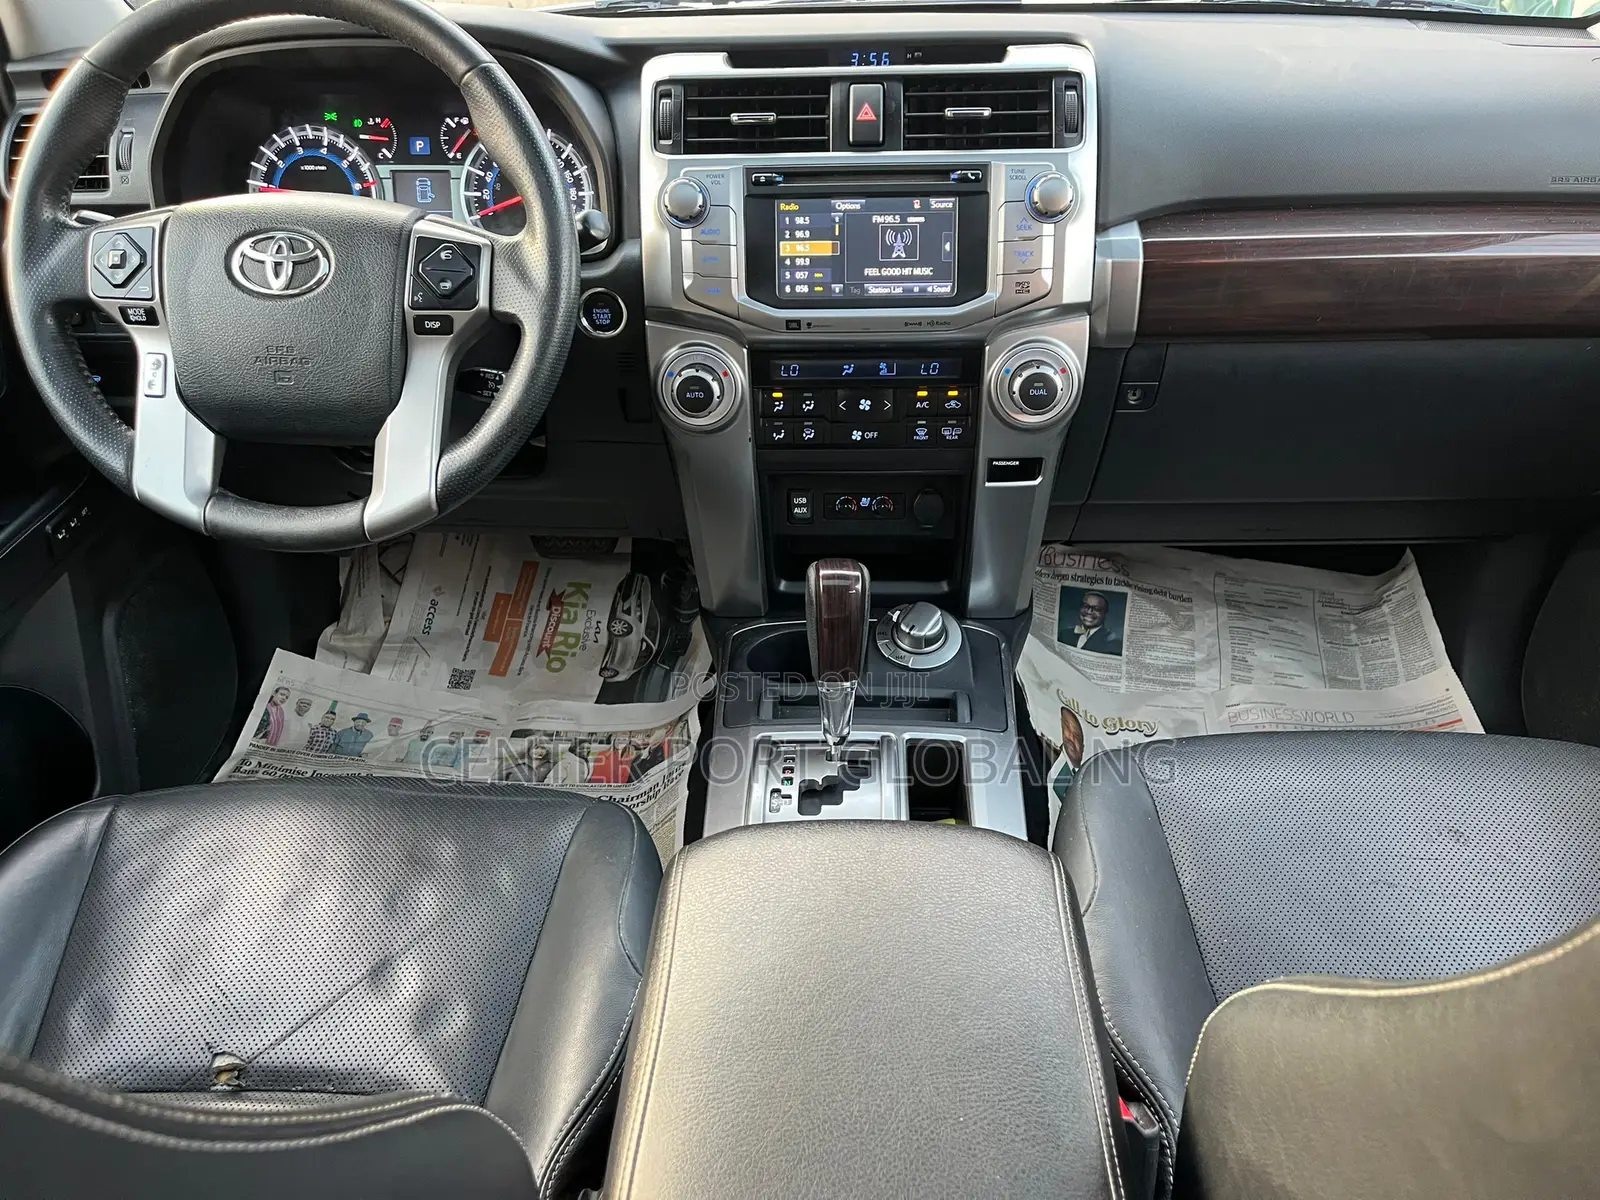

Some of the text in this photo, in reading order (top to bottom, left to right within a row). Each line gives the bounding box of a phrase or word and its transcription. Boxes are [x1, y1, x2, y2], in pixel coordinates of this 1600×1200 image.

[851, 52, 890, 66] 3:56
[297, 147, 304, 155] 3
[320, 147, 328, 155] 4
[416, 141, 424, 152] P
[277, 161, 286, 169] 2
[341, 160, 350, 169] 5
[485, 171, 494, 183] 40
[482, 189, 491, 200] 20
[780, 203, 799, 211] Radio
[835, 202, 861, 211] Options
[930, 201, 953, 209] Source
[795, 230, 810, 238] 96.9
[795, 244, 810, 252] 96.5
[785, 258, 810, 266] 4 99.9
[785, 271, 790, 279] 5
[795, 271, 808, 279] 057
[864, 267, 933, 276] FEEL GOOD HIT MUSIC
[795, 285, 809, 293] 056
[850, 286, 861, 296] Tag
[890, 285, 903, 293] List
[933, 285, 951, 293] Sound
[127, 308, 146, 316] MODE
[424, 321, 441, 329] DISP
[781, 364, 799, 377] LO
[920, 362, 939, 375] LO
[1029, 388, 1047, 396] DUAL
[916, 401, 930, 409] A/C
[1071, 573, 1105, 586] strategies
[1105, 576, 1113, 585] to
[1168, 590, 1193, 603] burden
[422, 598, 439, 636] access
[542, 606, 561, 648] Discount
[546, 582, 593, 673] Kia Rio
[579, 609, 597, 652] Exclusive
[1056, 688, 1160, 737] Call to Glory
[232, 765, 260, 775] Bans
[240, 758, 253, 766] To
[255, 761, 308, 777] Minimise
[599, 782, 660, 803] Chairman
